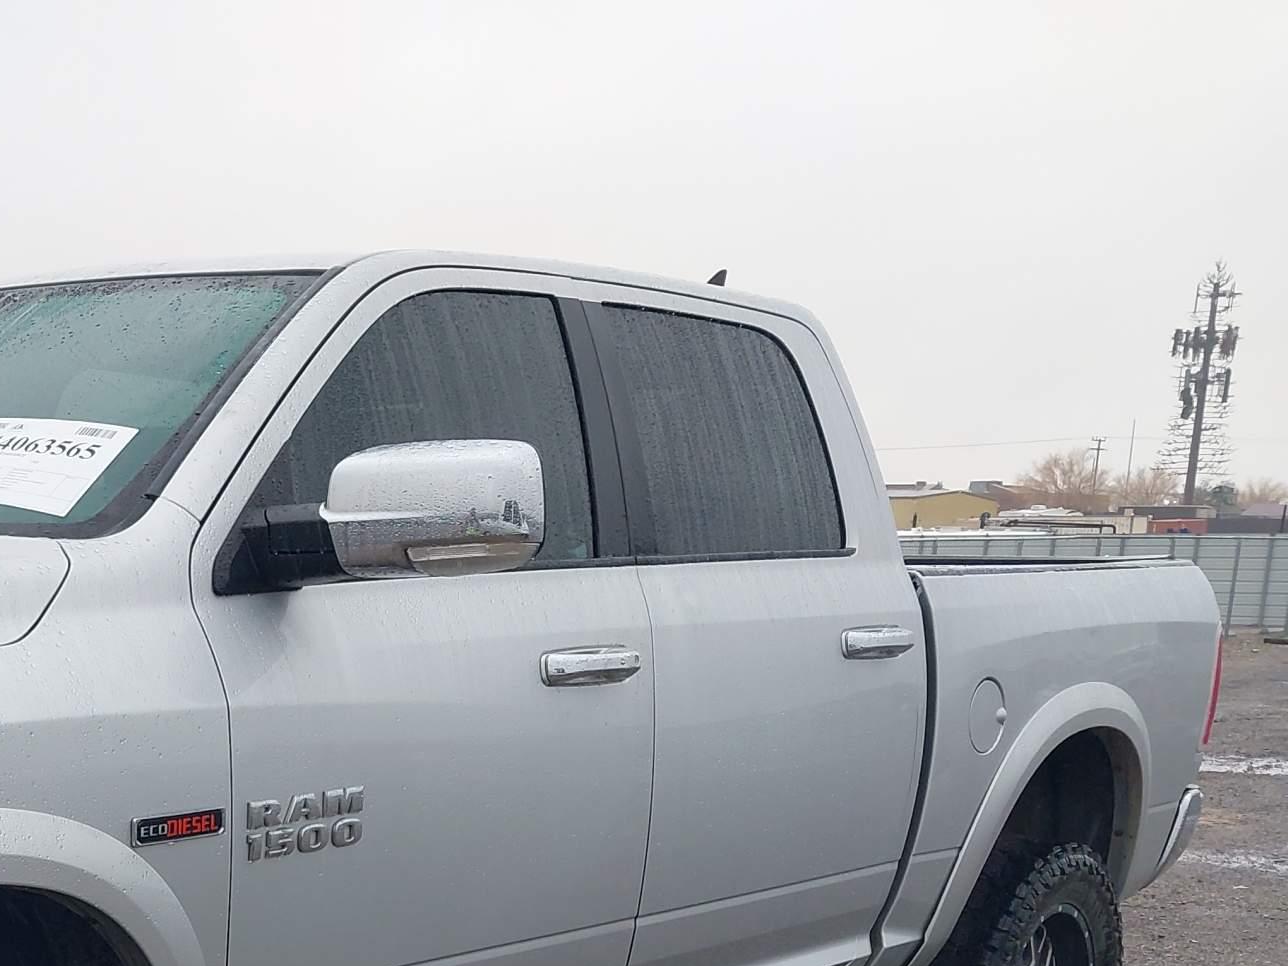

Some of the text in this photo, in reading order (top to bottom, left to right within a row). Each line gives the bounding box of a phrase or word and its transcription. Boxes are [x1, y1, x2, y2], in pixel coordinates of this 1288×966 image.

[140, 813, 218, 838] ECODIESEL
[246, 785, 365, 831] RAM
[246, 817, 362, 863] 1500
